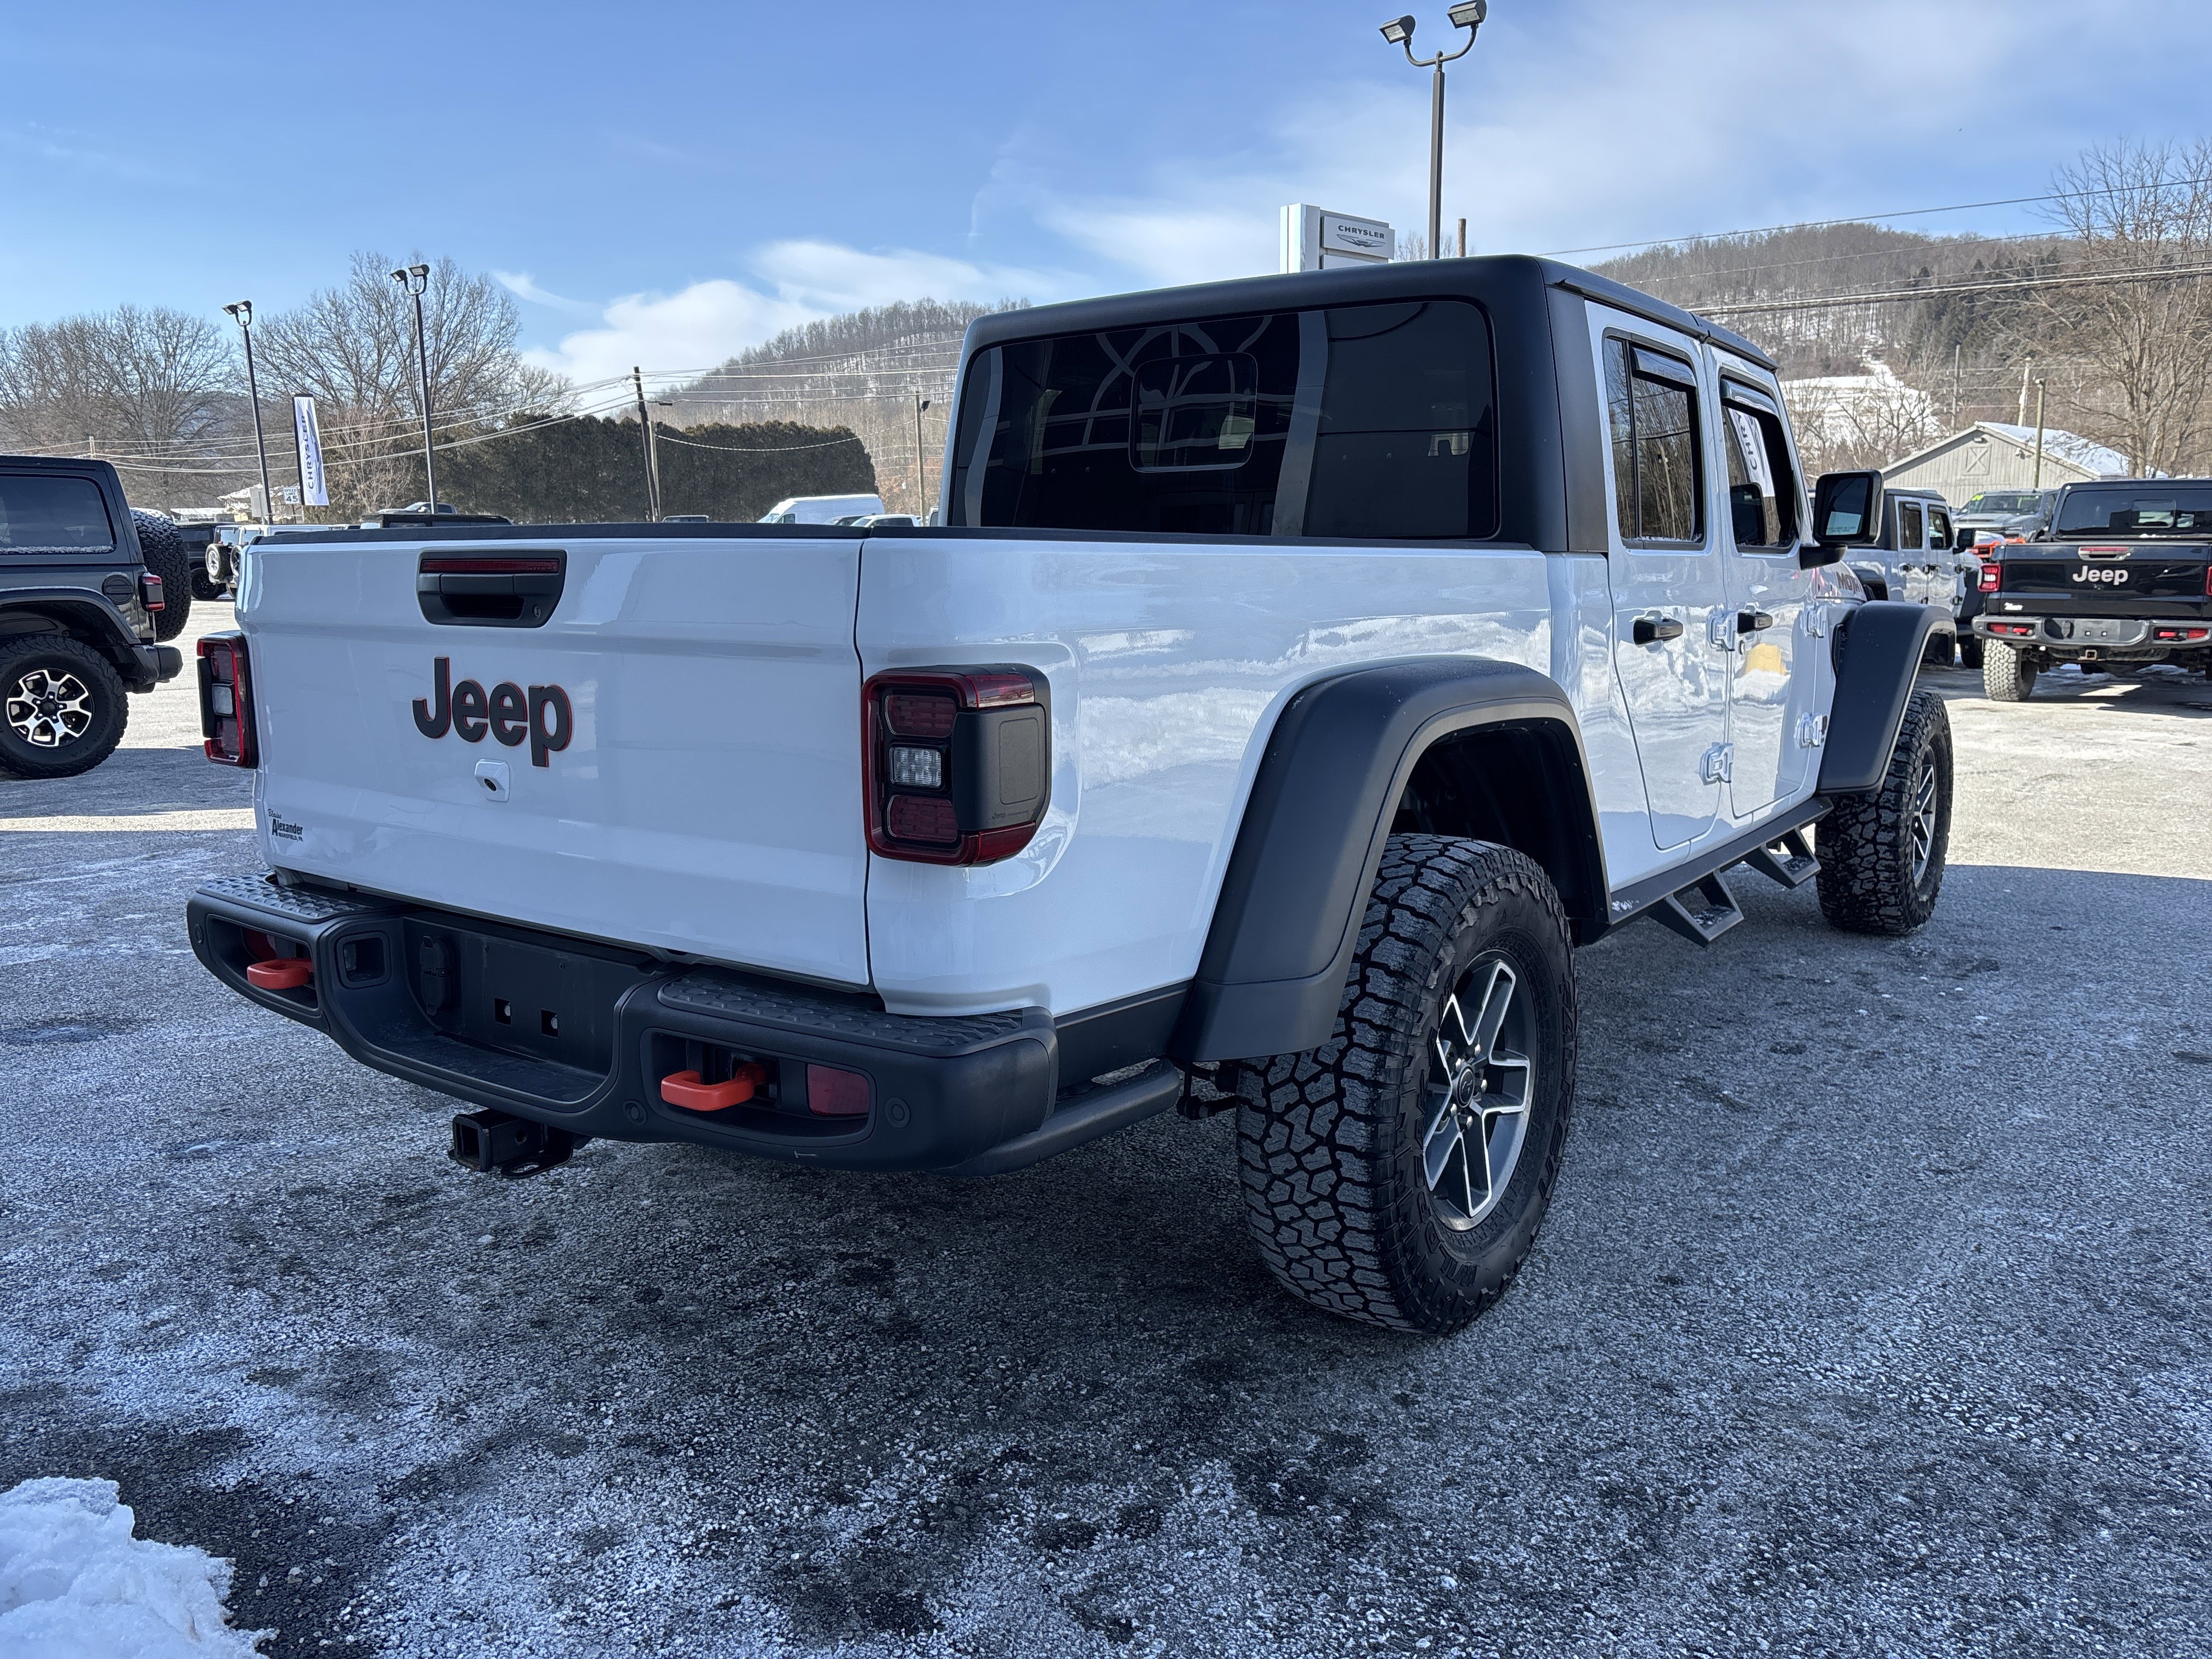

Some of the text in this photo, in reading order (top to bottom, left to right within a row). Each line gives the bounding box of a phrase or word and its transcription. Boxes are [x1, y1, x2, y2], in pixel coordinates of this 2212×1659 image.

[1338, 225, 1385, 239] CHRYSLER
[301, 415, 314, 489] CHRYSLER
[2072, 565, 2129, 585] Jeep
[412, 657, 572, 768] Jeep
[272, 818, 303, 836] Alexander
